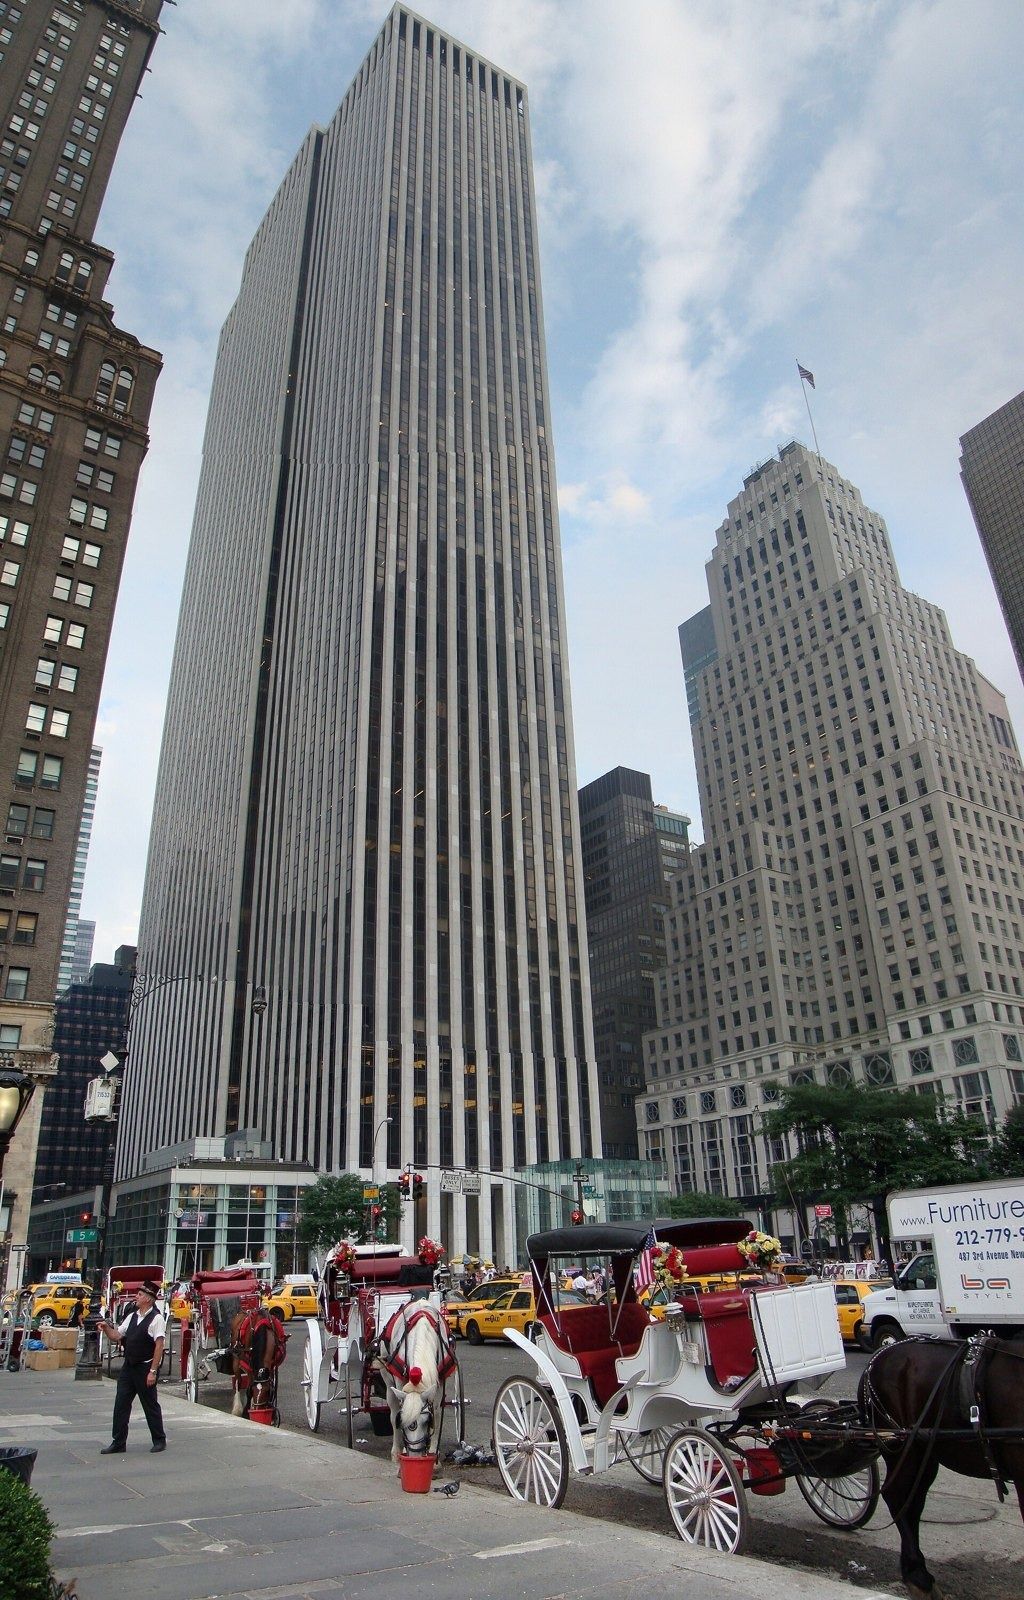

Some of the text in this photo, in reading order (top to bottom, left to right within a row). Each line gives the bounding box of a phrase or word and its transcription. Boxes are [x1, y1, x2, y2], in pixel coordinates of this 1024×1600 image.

[79, 1231, 86, 1240] 5
[959, 1252, 970, 1261] 487
[972, 1251, 984, 1261] 3rd
[986, 1250, 1009, 1260] Avenue
